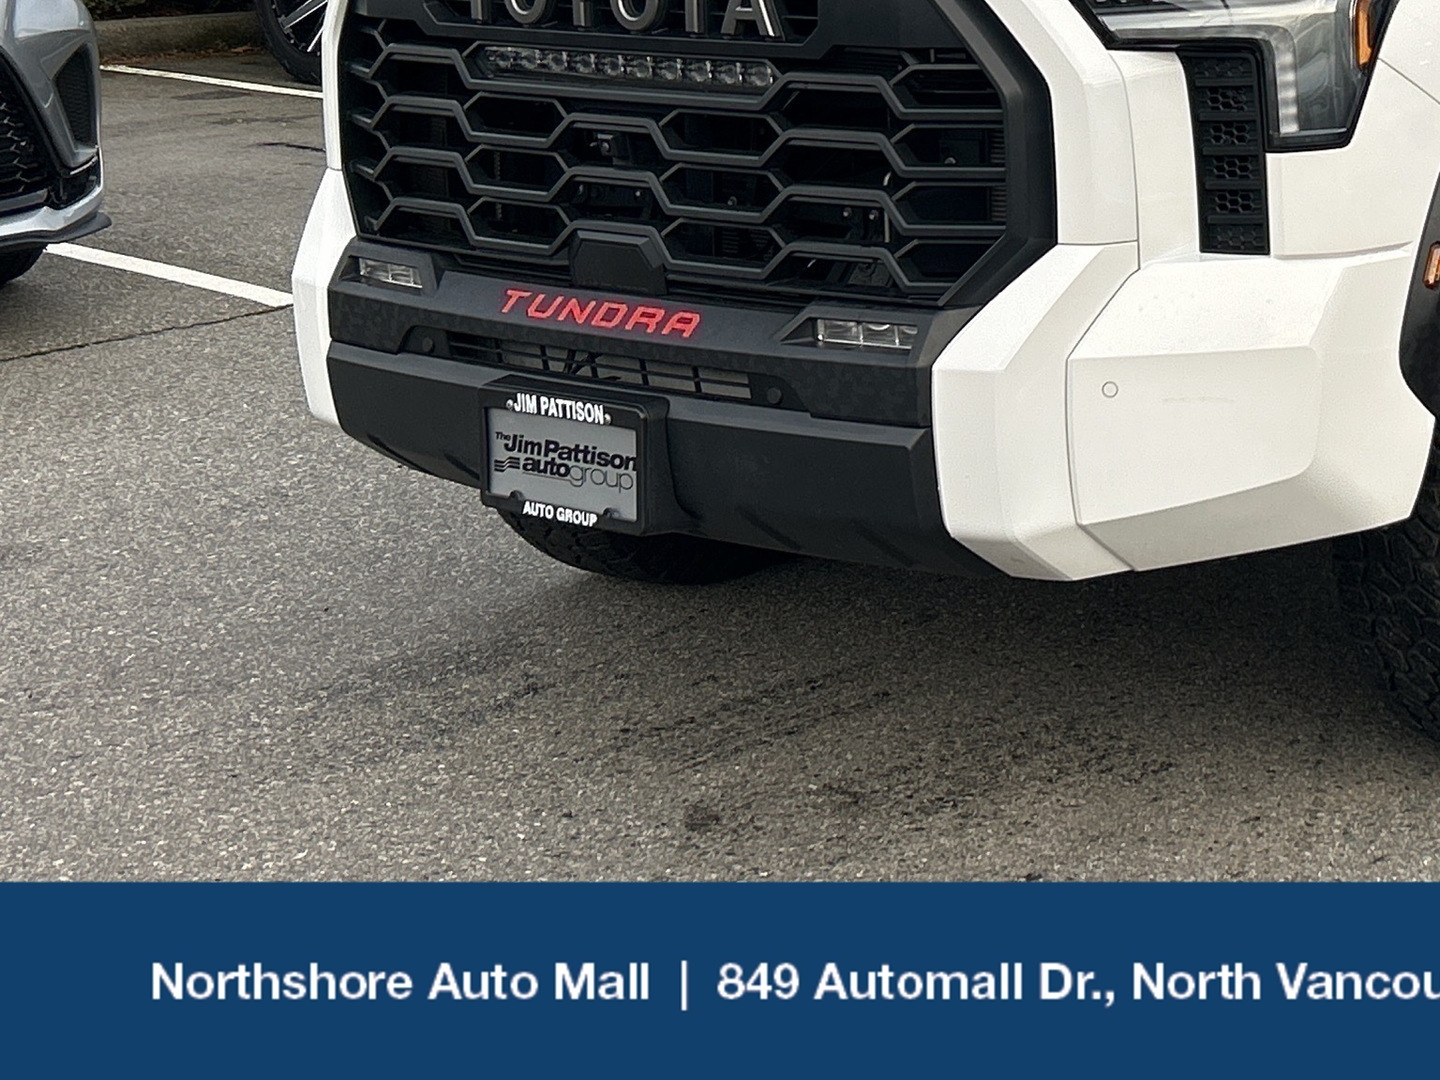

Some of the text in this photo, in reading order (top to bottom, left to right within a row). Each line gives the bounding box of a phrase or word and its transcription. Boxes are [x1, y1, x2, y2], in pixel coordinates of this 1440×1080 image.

[503, 289, 701, 338] TUNDRA
[513, 392, 605, 425] JIM PATTISON
[495, 431, 511, 441] The
[504, 434, 638, 471] Jim Pattison
[523, 501, 598, 527] AUTO GROUP
